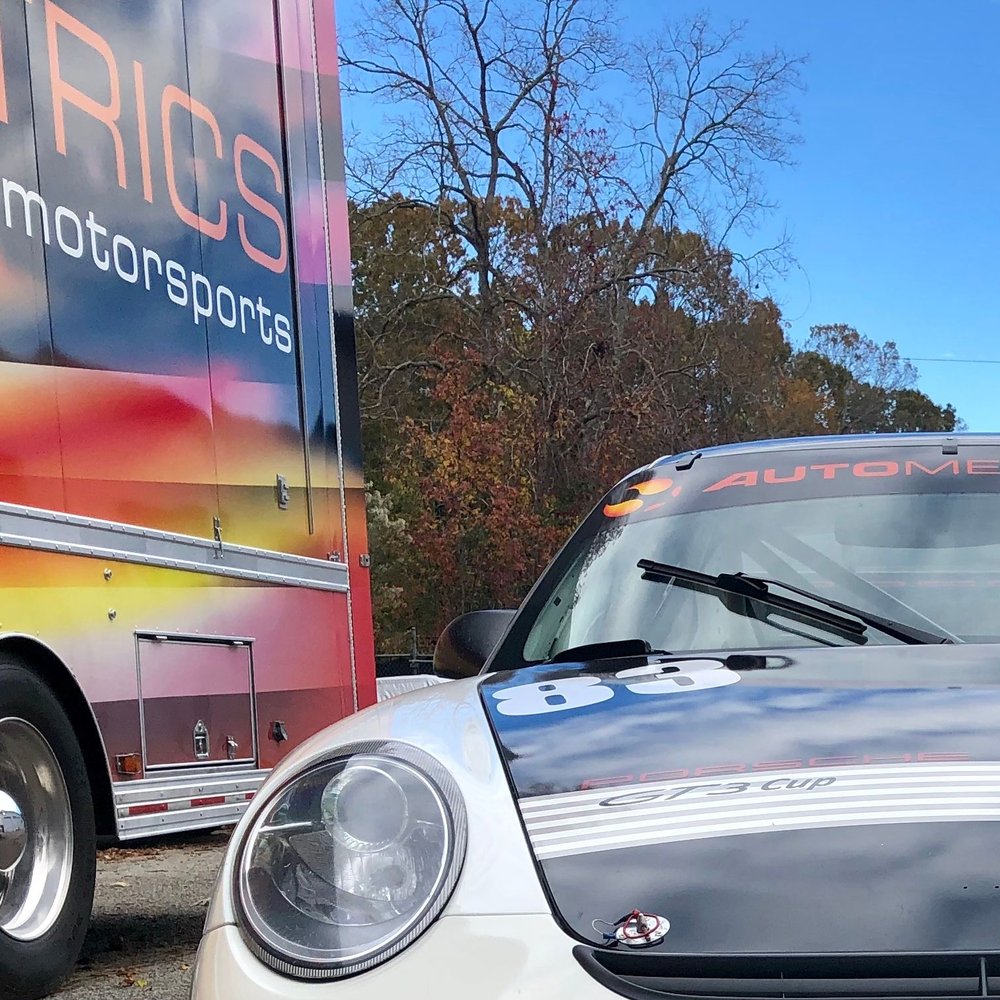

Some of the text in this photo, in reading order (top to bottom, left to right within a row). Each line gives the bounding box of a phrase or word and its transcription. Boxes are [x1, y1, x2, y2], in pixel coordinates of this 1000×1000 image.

[2, 177, 292, 354] motorsports
[492, 659, 742, 716] 83
[580, 752, 969, 790] PORSCHE
[599, 776, 837, 806] GT3 Cup
